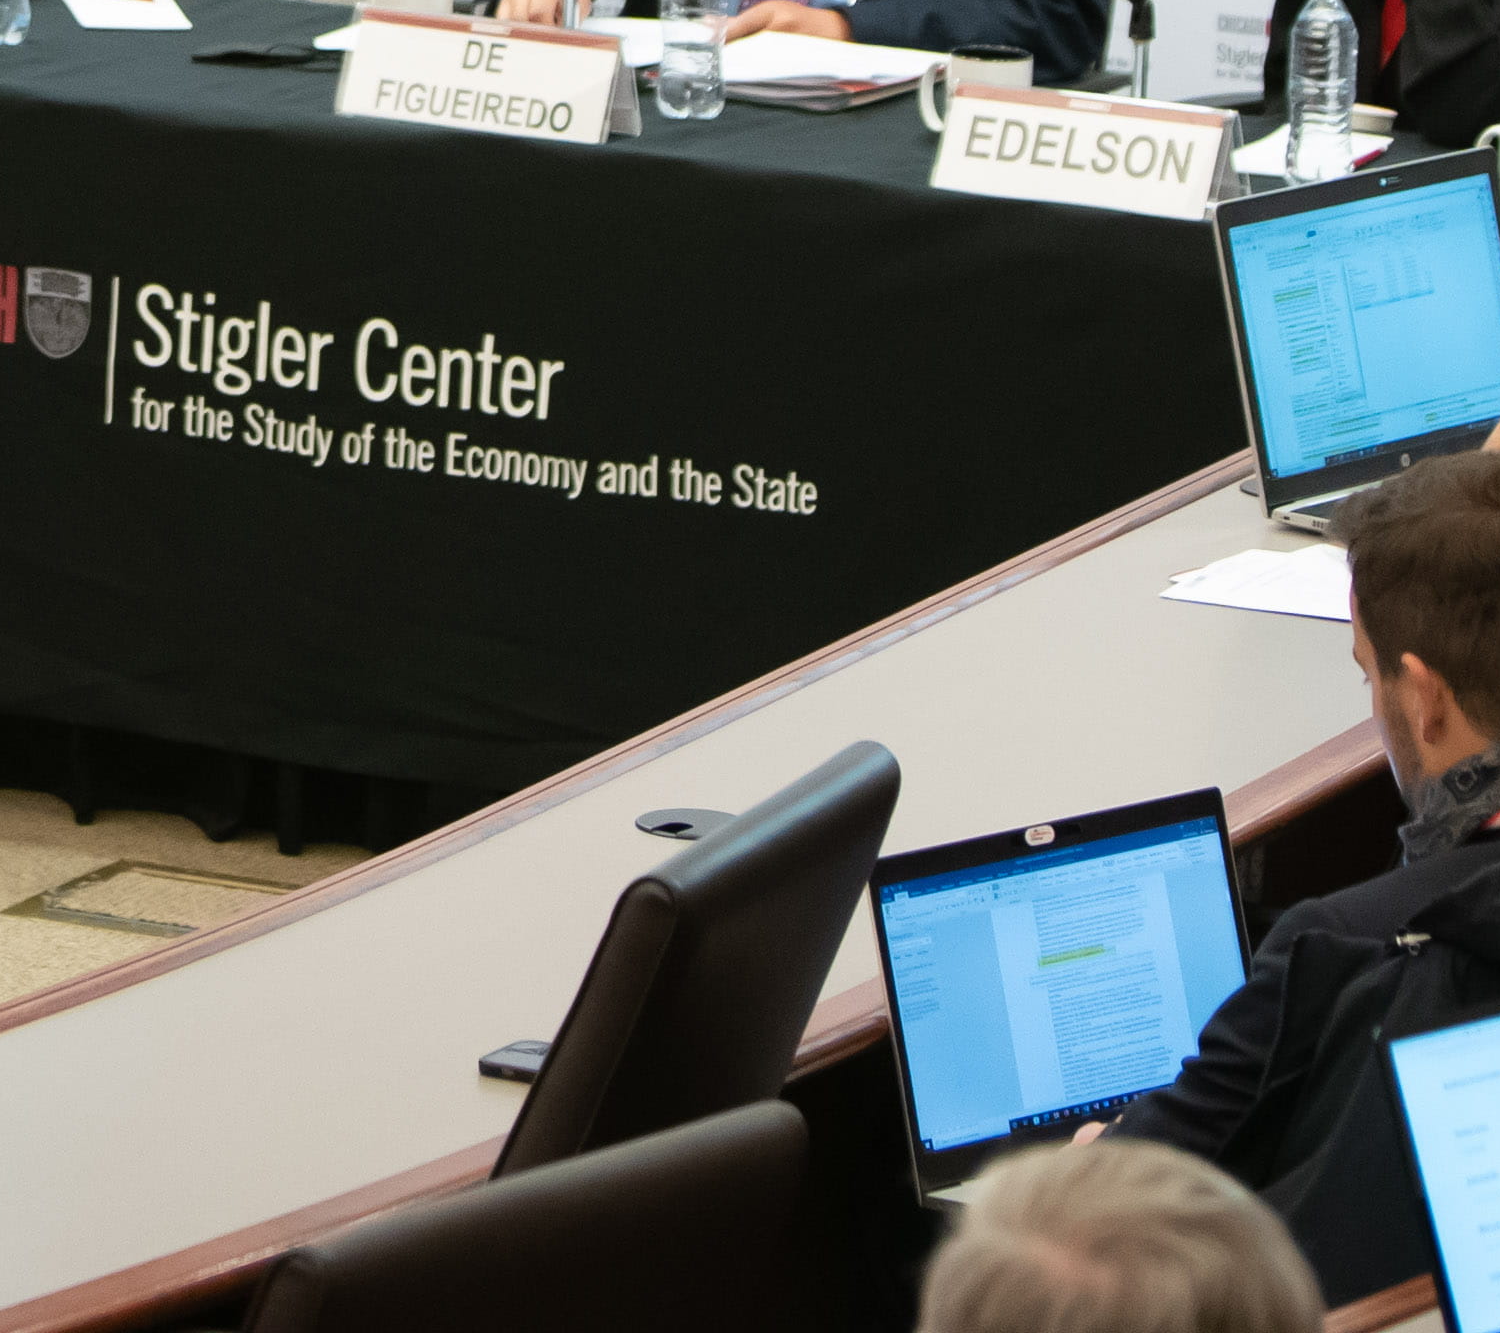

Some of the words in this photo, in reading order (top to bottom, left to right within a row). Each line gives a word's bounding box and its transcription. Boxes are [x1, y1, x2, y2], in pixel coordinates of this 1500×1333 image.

[461, 39, 504, 73] DE
[374, 79, 574, 133] FIGUEIREDO
[963, 115, 1195, 185] EDELSON
[132, 283, 334, 395] Stigler
[355, 318, 564, 420] Center
[131, 387, 175, 431] for
[183, 396, 234, 442] the
[242, 402, 333, 467] Study
[342, 423, 376, 465] of
[384, 427, 435, 473] the
[445, 433, 588, 499] Economy
[596, 455, 658, 498] and
[670, 458, 722, 505] the
[731, 464, 818, 515] State
